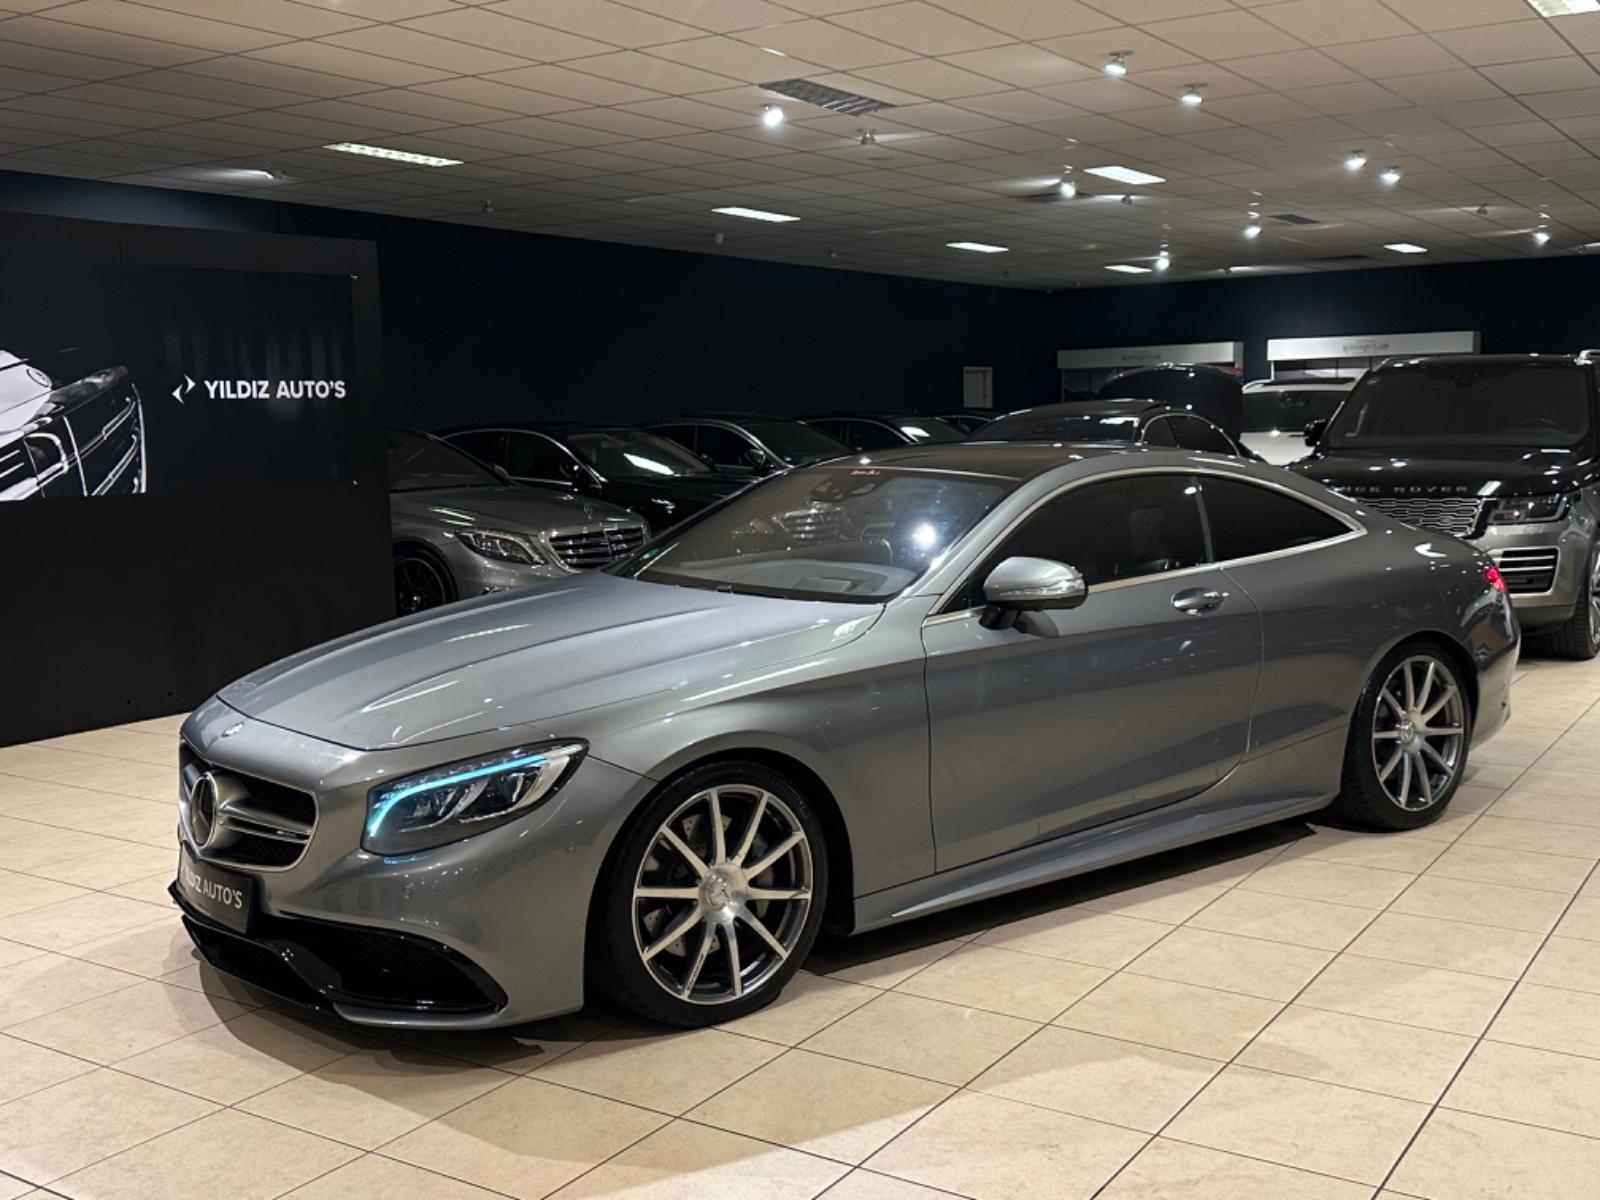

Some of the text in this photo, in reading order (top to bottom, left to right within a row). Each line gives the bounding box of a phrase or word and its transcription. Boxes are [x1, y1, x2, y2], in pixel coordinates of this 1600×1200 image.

[203, 379, 347, 399] YILDIZ AUTO'S
[1393, 485, 1469, 493] ROVER
[203, 879, 243, 910] AUTO'S
